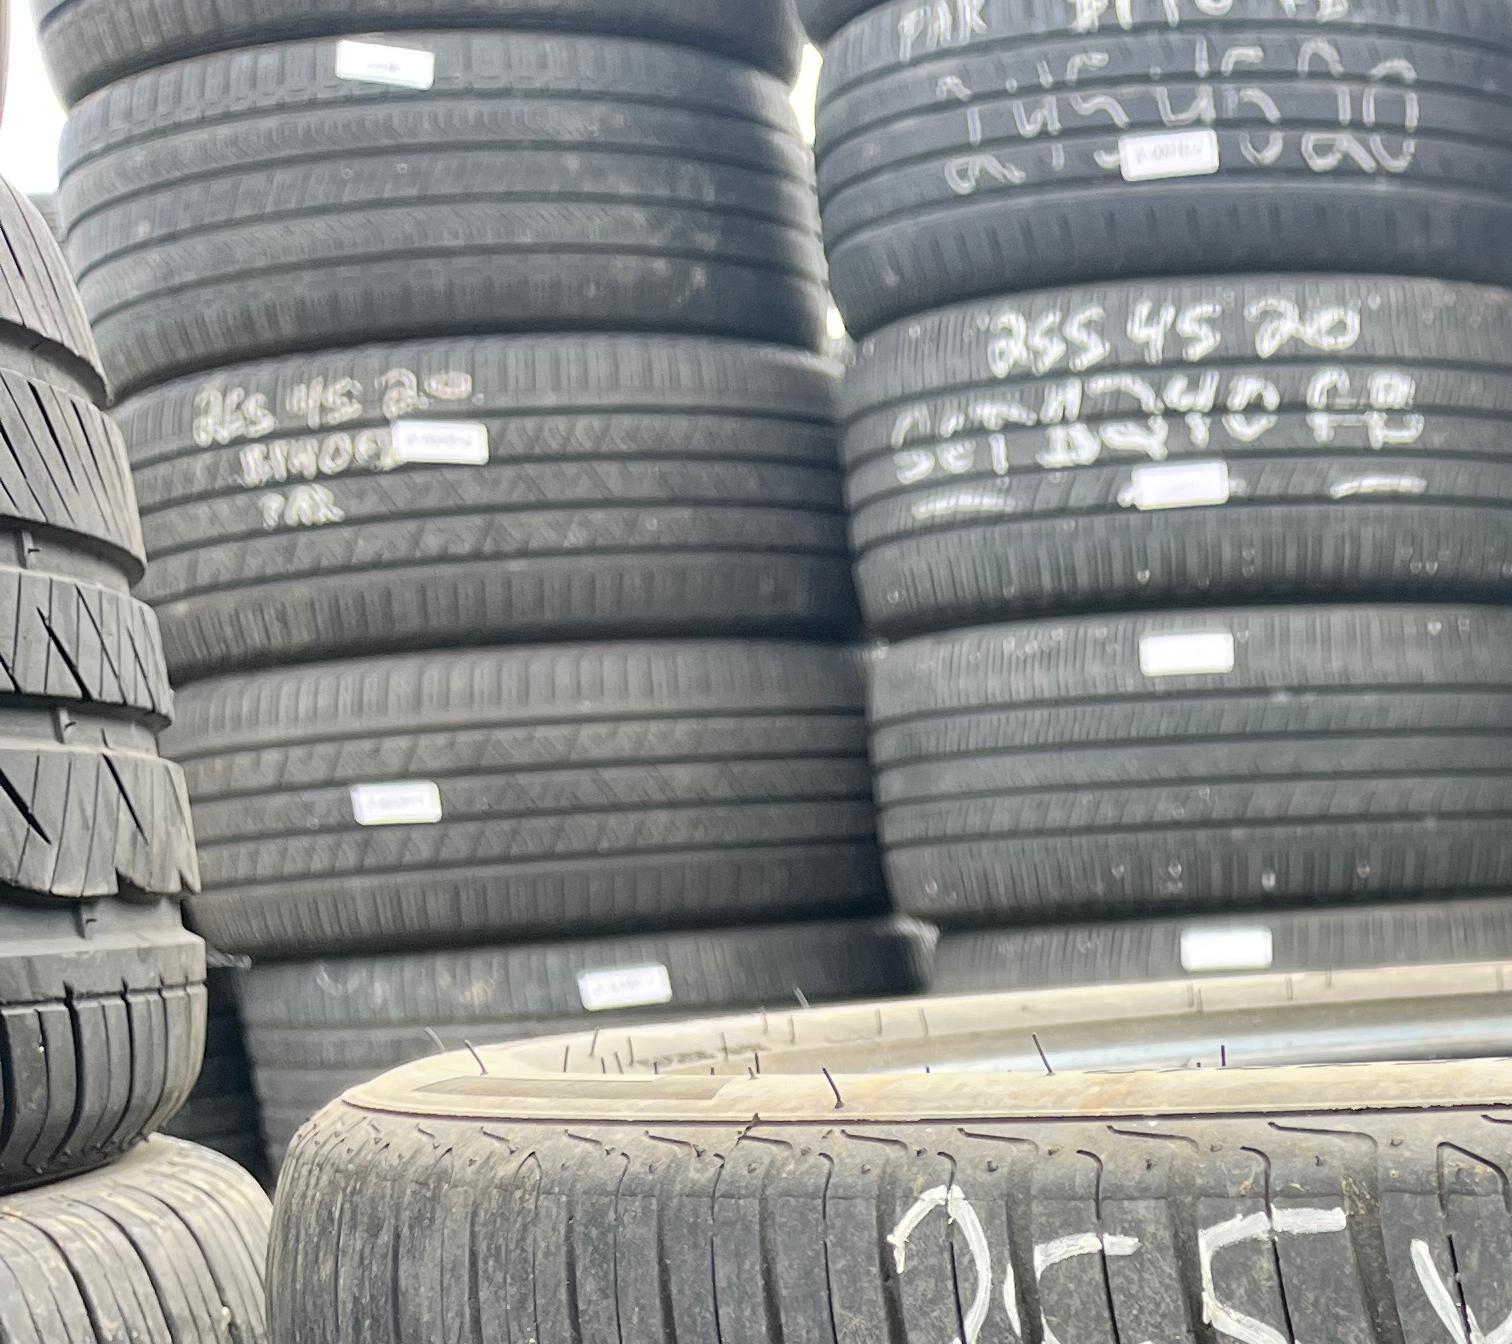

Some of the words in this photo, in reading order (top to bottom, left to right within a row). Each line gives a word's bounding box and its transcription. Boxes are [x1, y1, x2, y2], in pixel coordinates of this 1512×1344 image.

[988, 308, 1110, 378] 255
[1127, 298, 1222, 365] 45
[1244, 298, 1362, 358] 20
